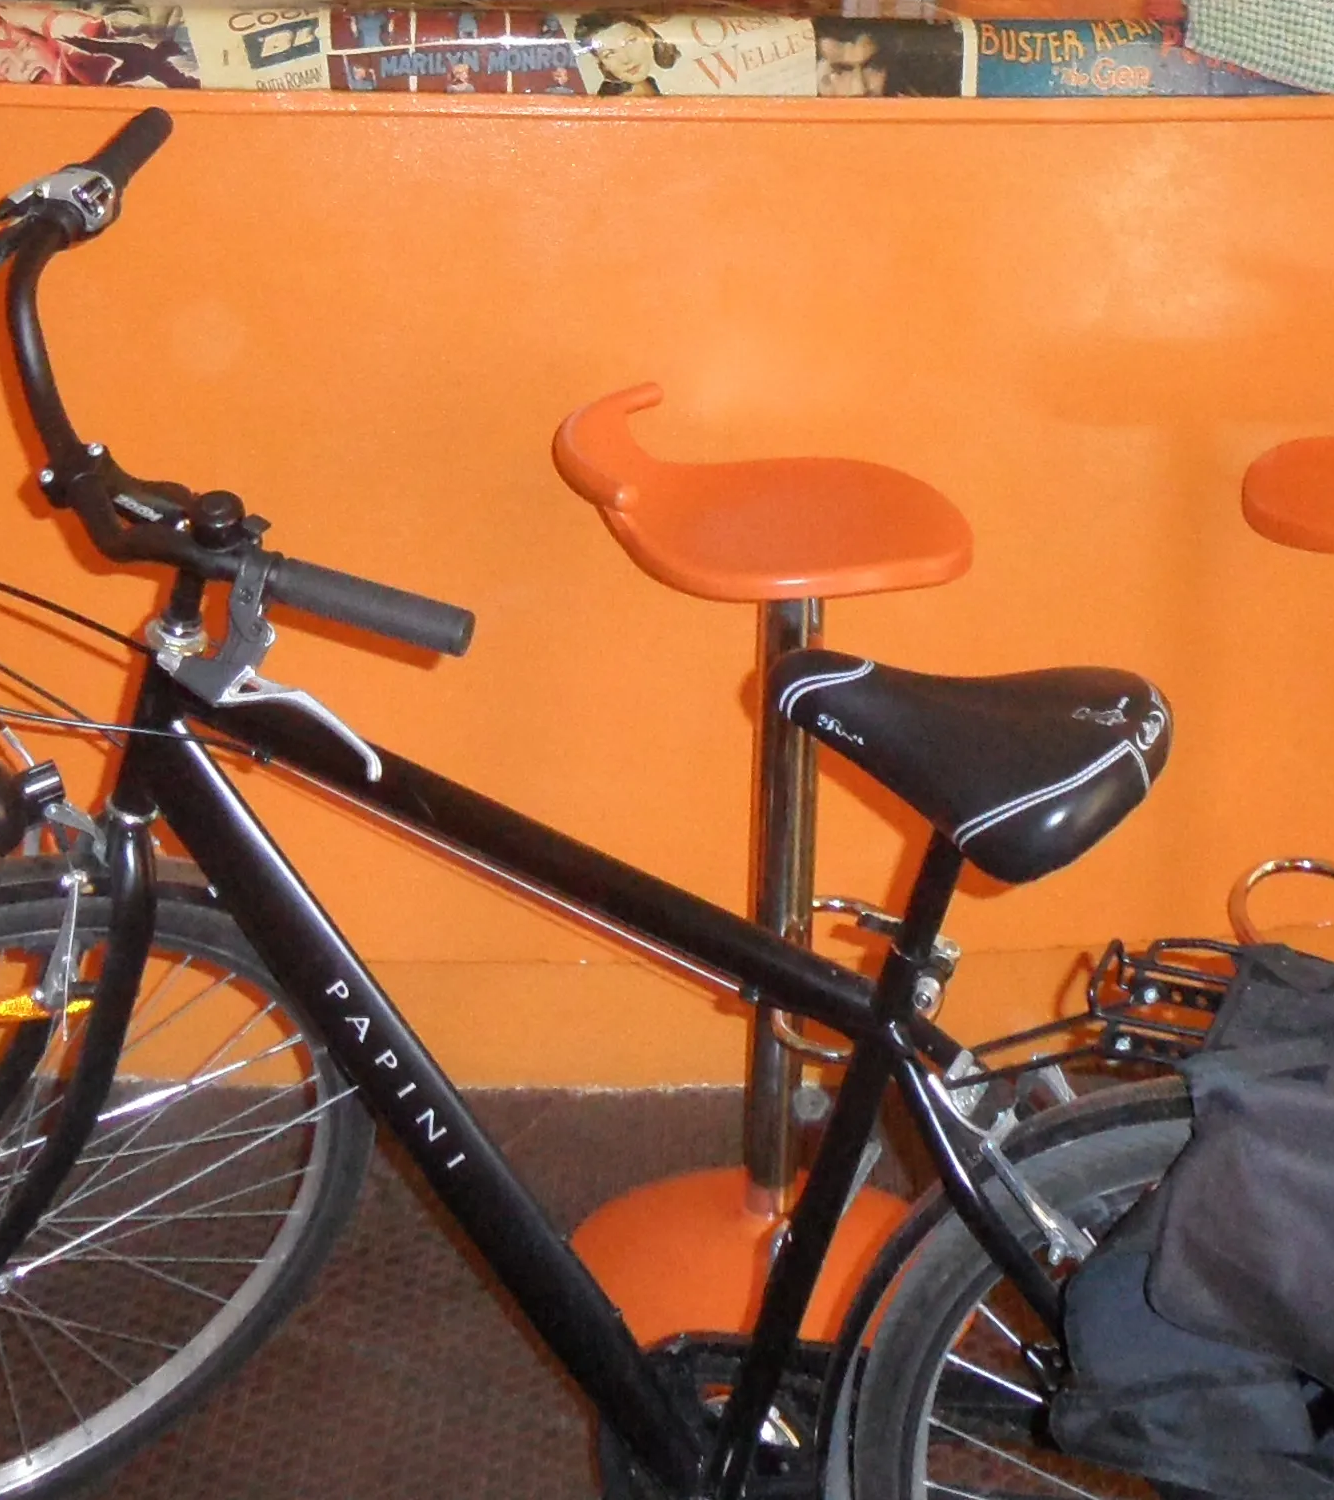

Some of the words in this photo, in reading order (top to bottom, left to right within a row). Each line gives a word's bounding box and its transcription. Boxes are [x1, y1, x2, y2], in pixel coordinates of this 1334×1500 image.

[380, 51, 479, 77] MARILYN
[980, 23, 1085, 64] BUSTER
[326, 980, 466, 1169] PAPINI
